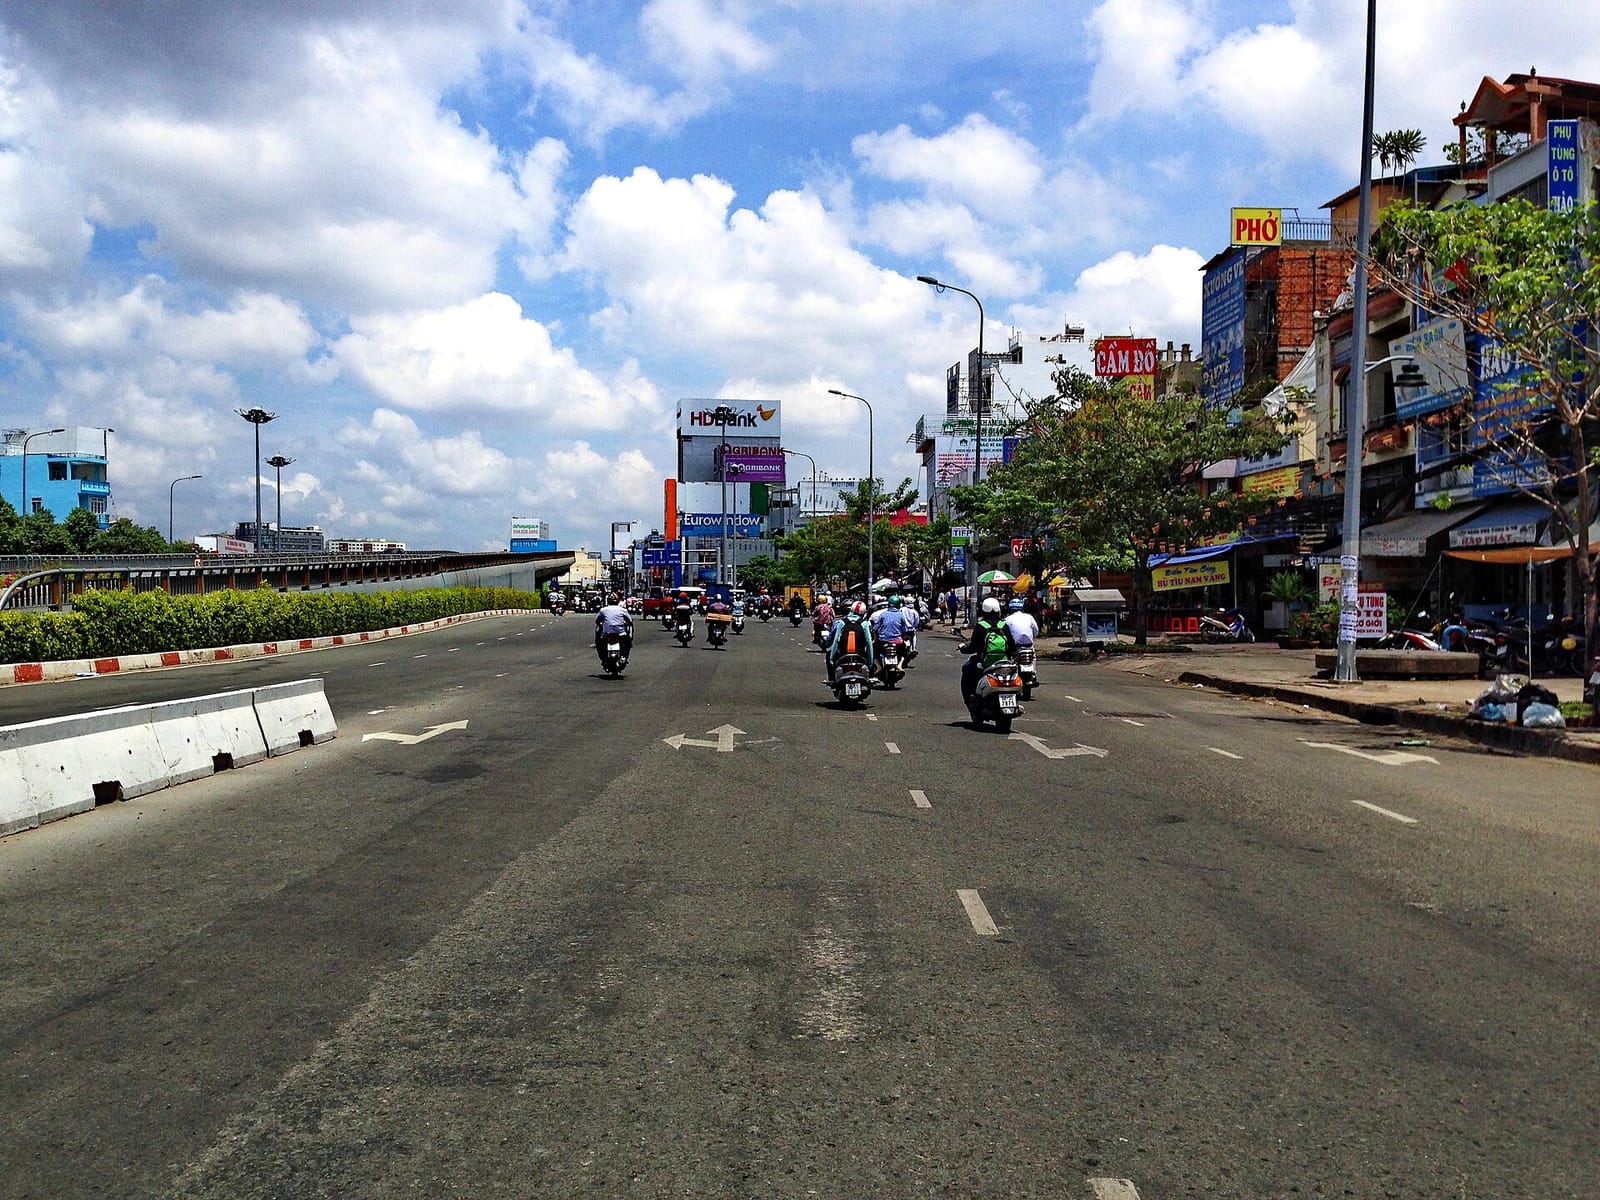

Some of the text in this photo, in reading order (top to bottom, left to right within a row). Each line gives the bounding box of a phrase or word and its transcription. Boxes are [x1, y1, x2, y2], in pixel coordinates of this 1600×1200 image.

[1553, 125, 1572, 142] PHỤ
[1551, 145, 1575, 161] TÙNG
[1552, 165, 1574, 182] Ô TÔ
[1236, 210, 1278, 242] PHỞ
[690, 410, 758, 428] HDBank
[683, 513, 760, 526] Eurowndow
[1184, 576, 1202, 585] NAM
[1202, 573, 1226, 583] VANG
